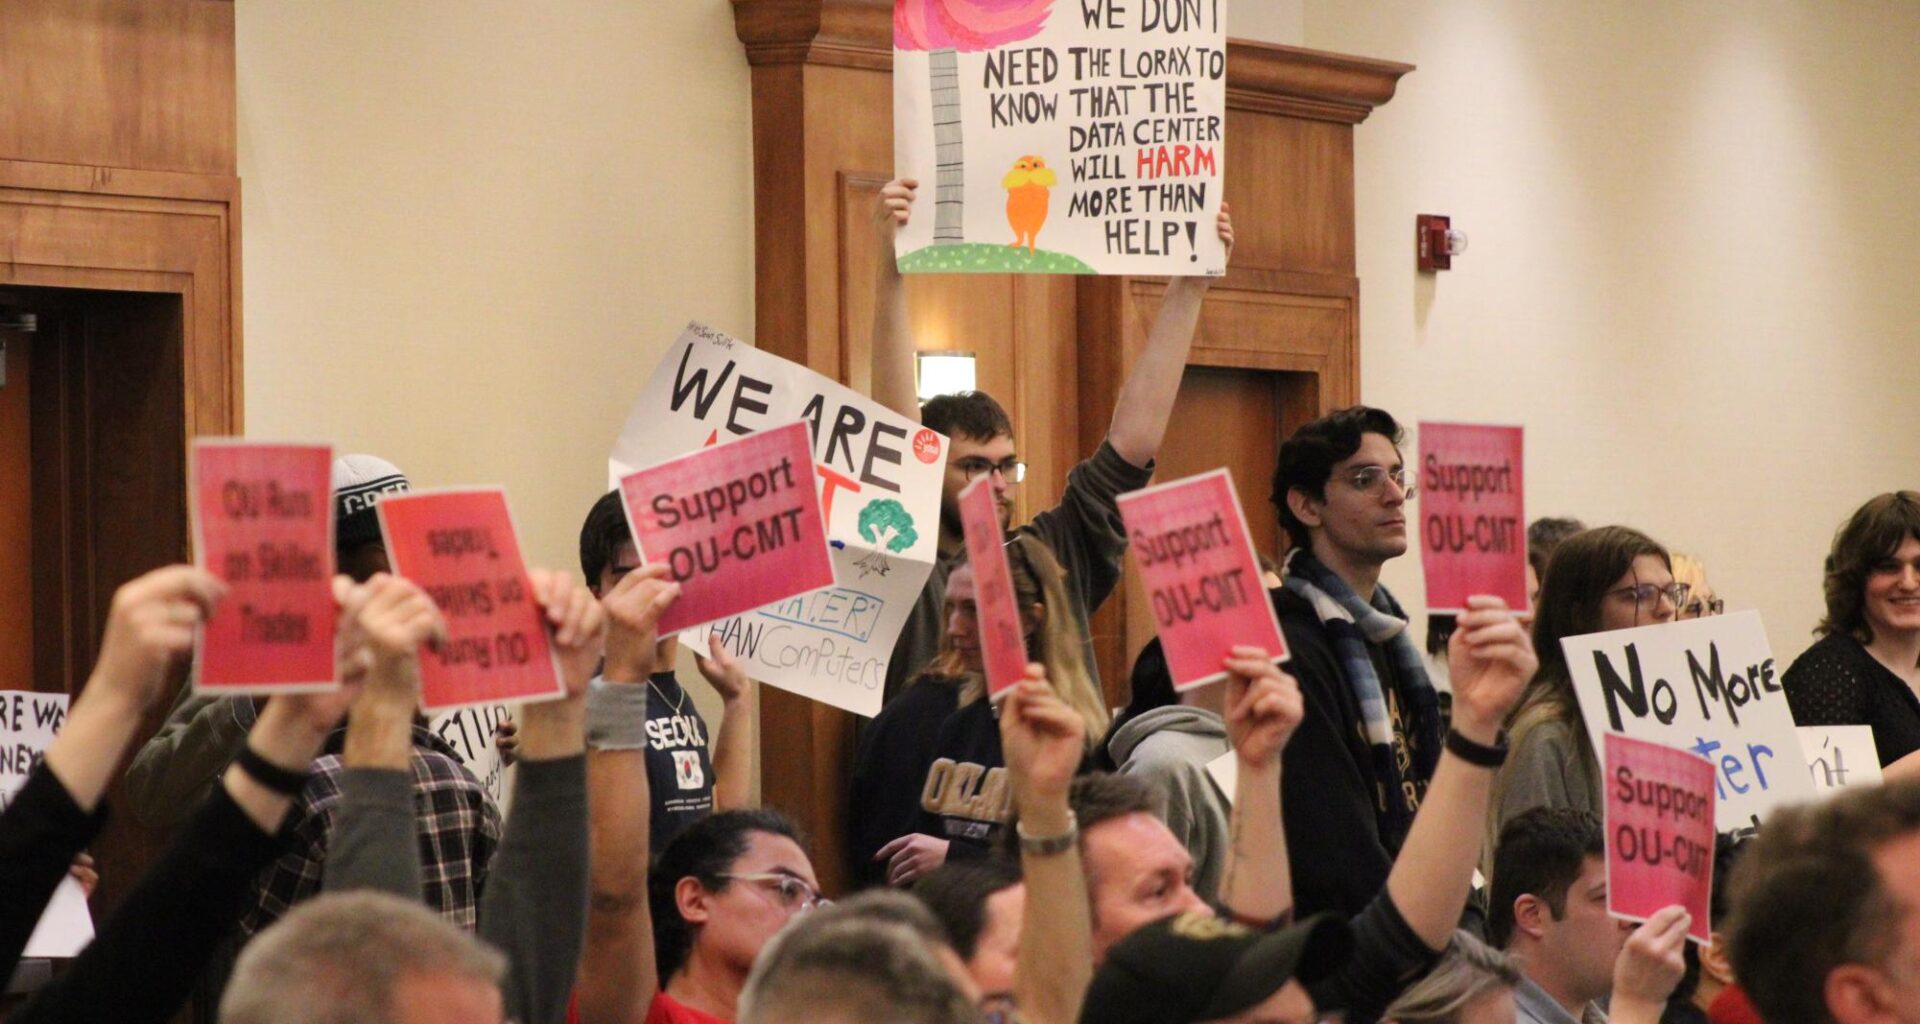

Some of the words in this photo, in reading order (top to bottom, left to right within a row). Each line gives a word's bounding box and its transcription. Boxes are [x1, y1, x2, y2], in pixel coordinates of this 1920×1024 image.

[1081, 0, 1125, 29] WE
[1141, 0, 1217, 33] DONT
[983, 47, 1058, 88] NEED
[1068, 46, 1111, 80] THE
[1120, 46, 1191, 78] LORAX
[1195, 48, 1224, 80] TO
[990, 91, 1058, 128] KNOW
[1069, 85, 1136, 118] THAT
[1143, 82, 1197, 114] THE
[1069, 121, 1126, 152] DATA
[1133, 116, 1220, 145] CENTER
[1071, 154, 1126, 183] WILL
[1137, 143, 1216, 179] HARM
[1068, 186, 1132, 218] MORE
[1138, 182, 1206, 213] THAN
[1105, 218, 1198, 262] HELP!
[670, 342, 773, 436] WE
[800, 394, 908, 493] ARE
[652, 456, 796, 528] Support
[1425, 454, 1513, 501] Support
[669, 506, 803, 582] OU-CMT
[1133, 511, 1230, 567] Support
[1427, 513, 1517, 555] OU-CMT
[1153, 568, 1249, 627] OU-CMT
[1593, 642, 1678, 733] No
[1688, 736, 1773, 801] ter
[1616, 766, 1708, 826] Support
